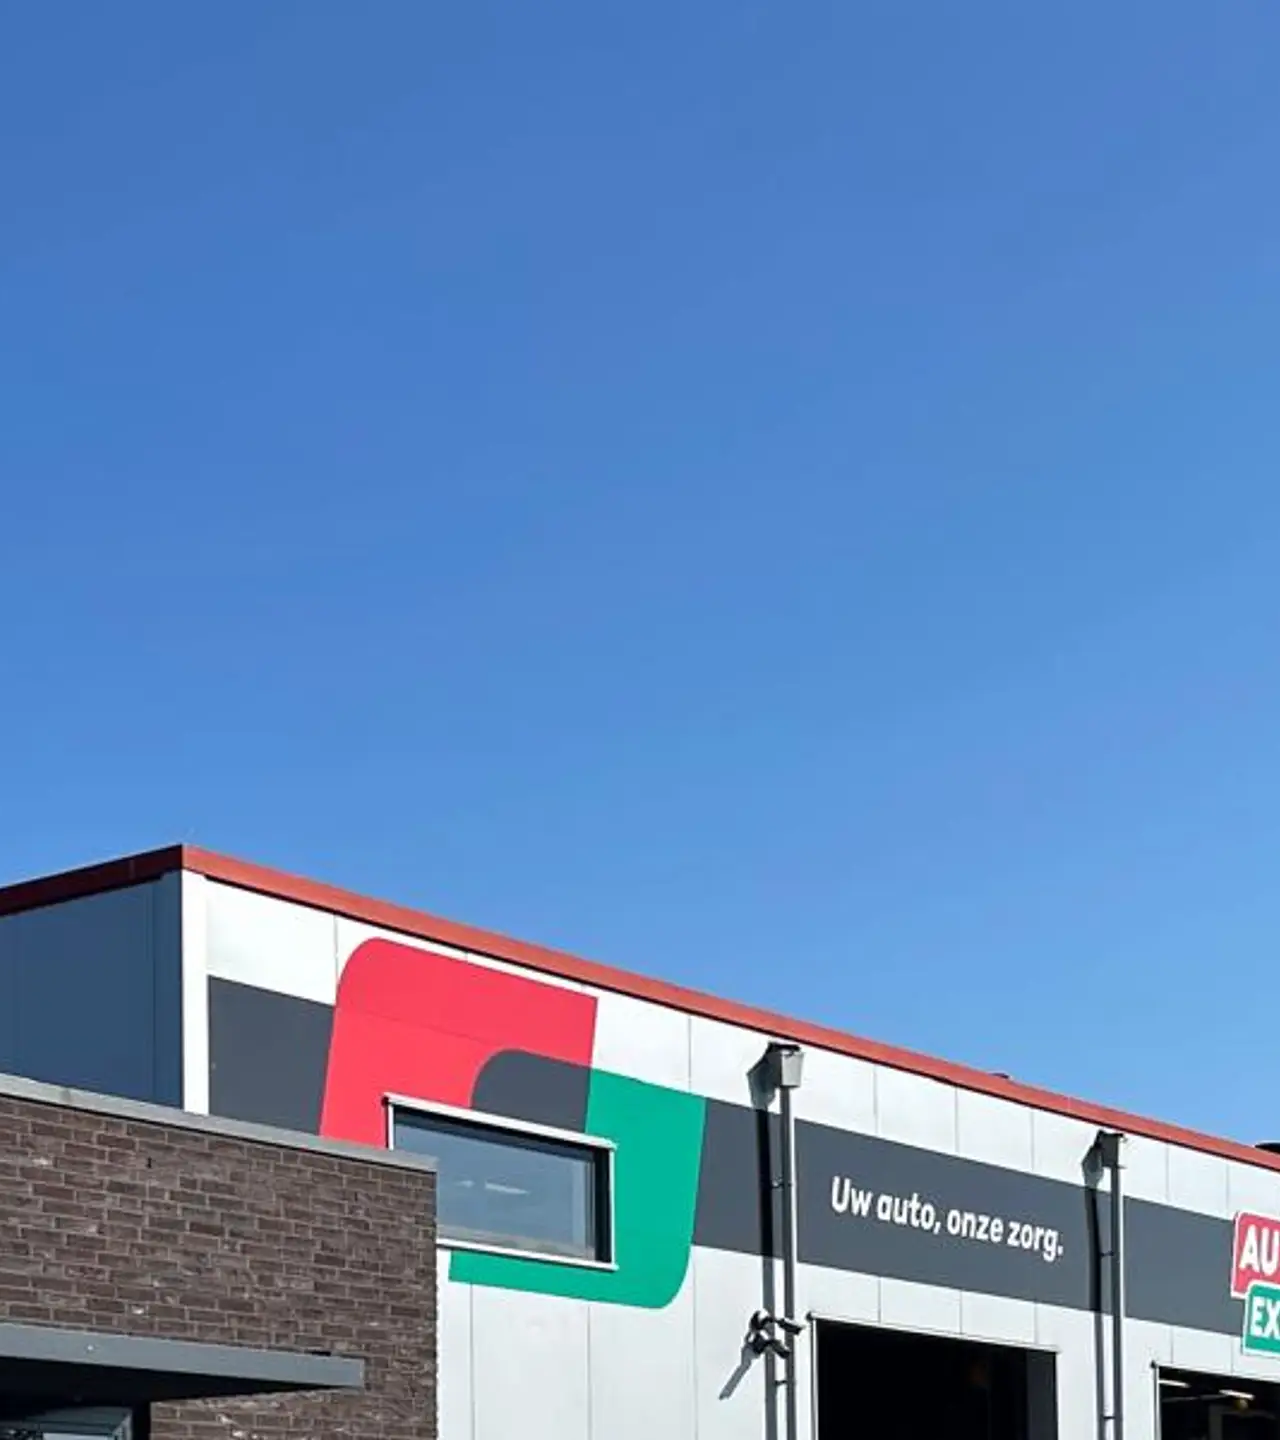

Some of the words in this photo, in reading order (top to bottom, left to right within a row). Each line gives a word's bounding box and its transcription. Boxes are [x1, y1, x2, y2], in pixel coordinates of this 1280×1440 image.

[831, 1175, 872, 1217] Uw
[877, 1192, 941, 1235] auto,
[947, 1208, 1004, 1243] onze
[1007, 1219, 1064, 1262] zorg.
